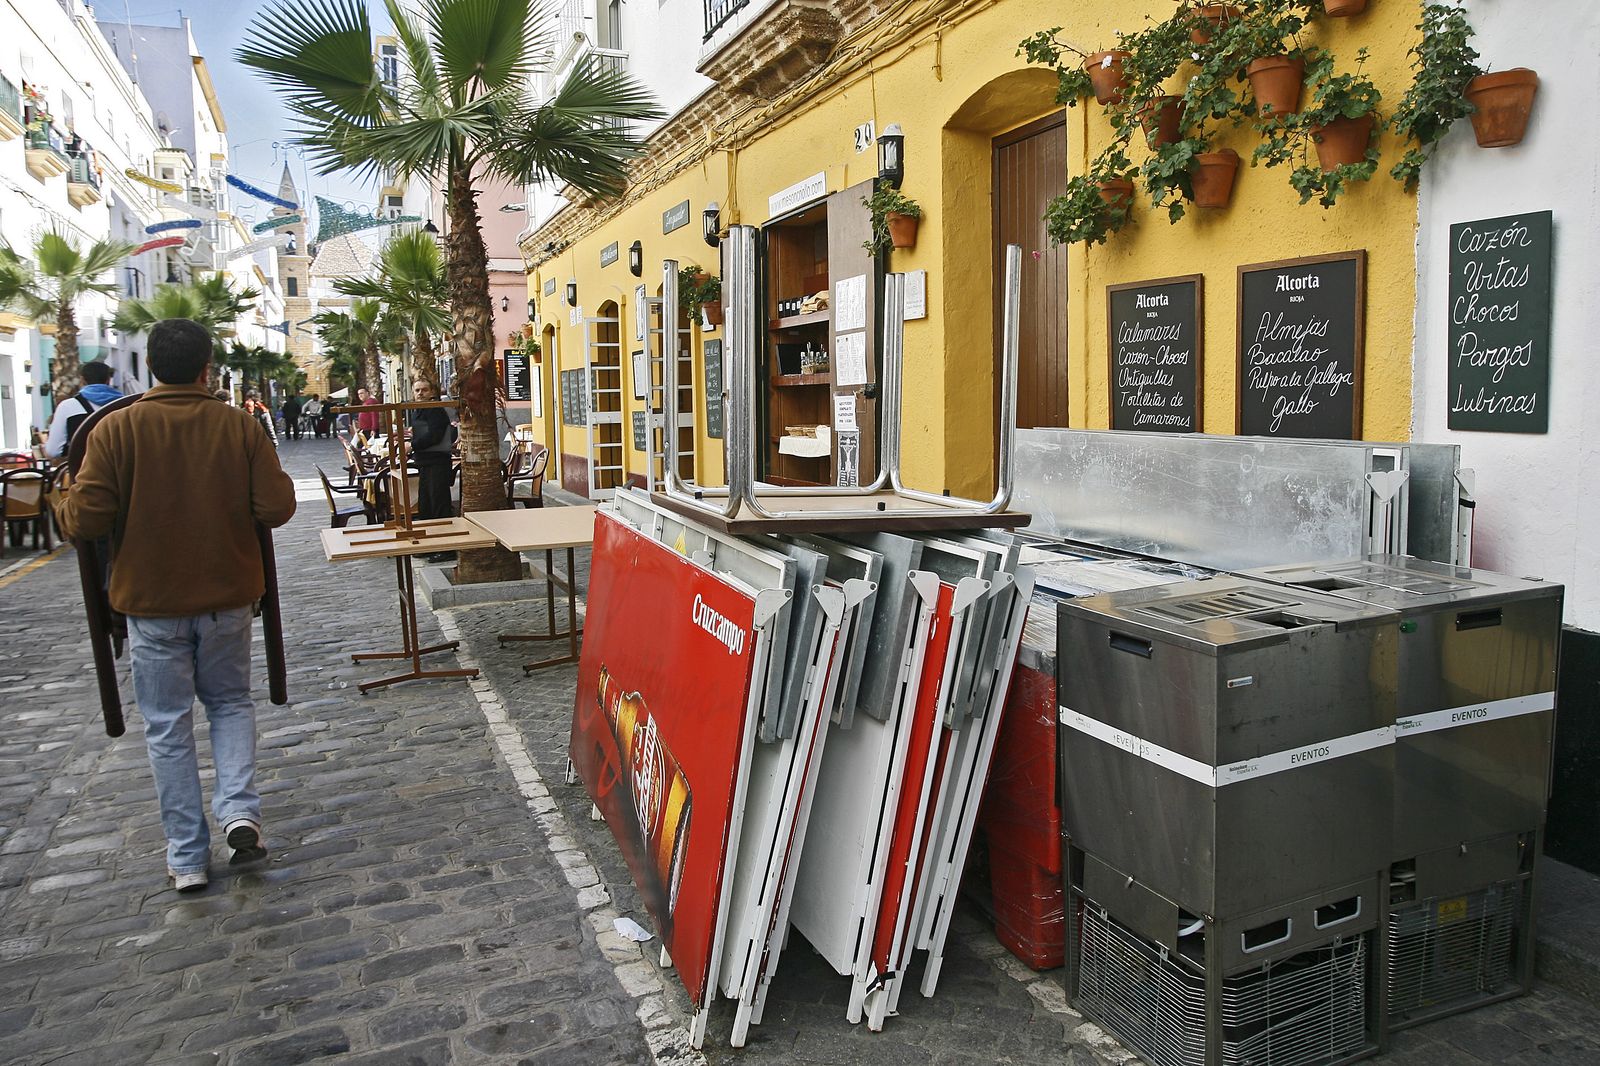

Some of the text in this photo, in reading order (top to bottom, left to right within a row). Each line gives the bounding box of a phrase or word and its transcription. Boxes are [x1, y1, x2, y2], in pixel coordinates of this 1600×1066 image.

[855, 123, 873, 150] 20
[1458, 222, 1532, 254] Cazón
[1275, 274, 1320, 292] Alcorta
[1135, 293, 1169, 309] Alcorta
[1454, 294, 1519, 325] Chocos
[1119, 321, 1181, 343] Calamares
[1255, 312, 1330, 351] Almejas
[1248, 343, 1329, 366] Bacalao
[1457, 331, 1533, 383] Pargos
[1289, 371, 1301, 387] la
[1170, 391, 1183, 407] de
[1452, 384, 1536, 414] Lubinas
[1133, 408, 1190, 427] Camarones
[692, 593, 744, 655] Cruzcampo
[1452, 708, 1487, 722] EVENTOS
[1291, 747, 1330, 763] EVENTOS
